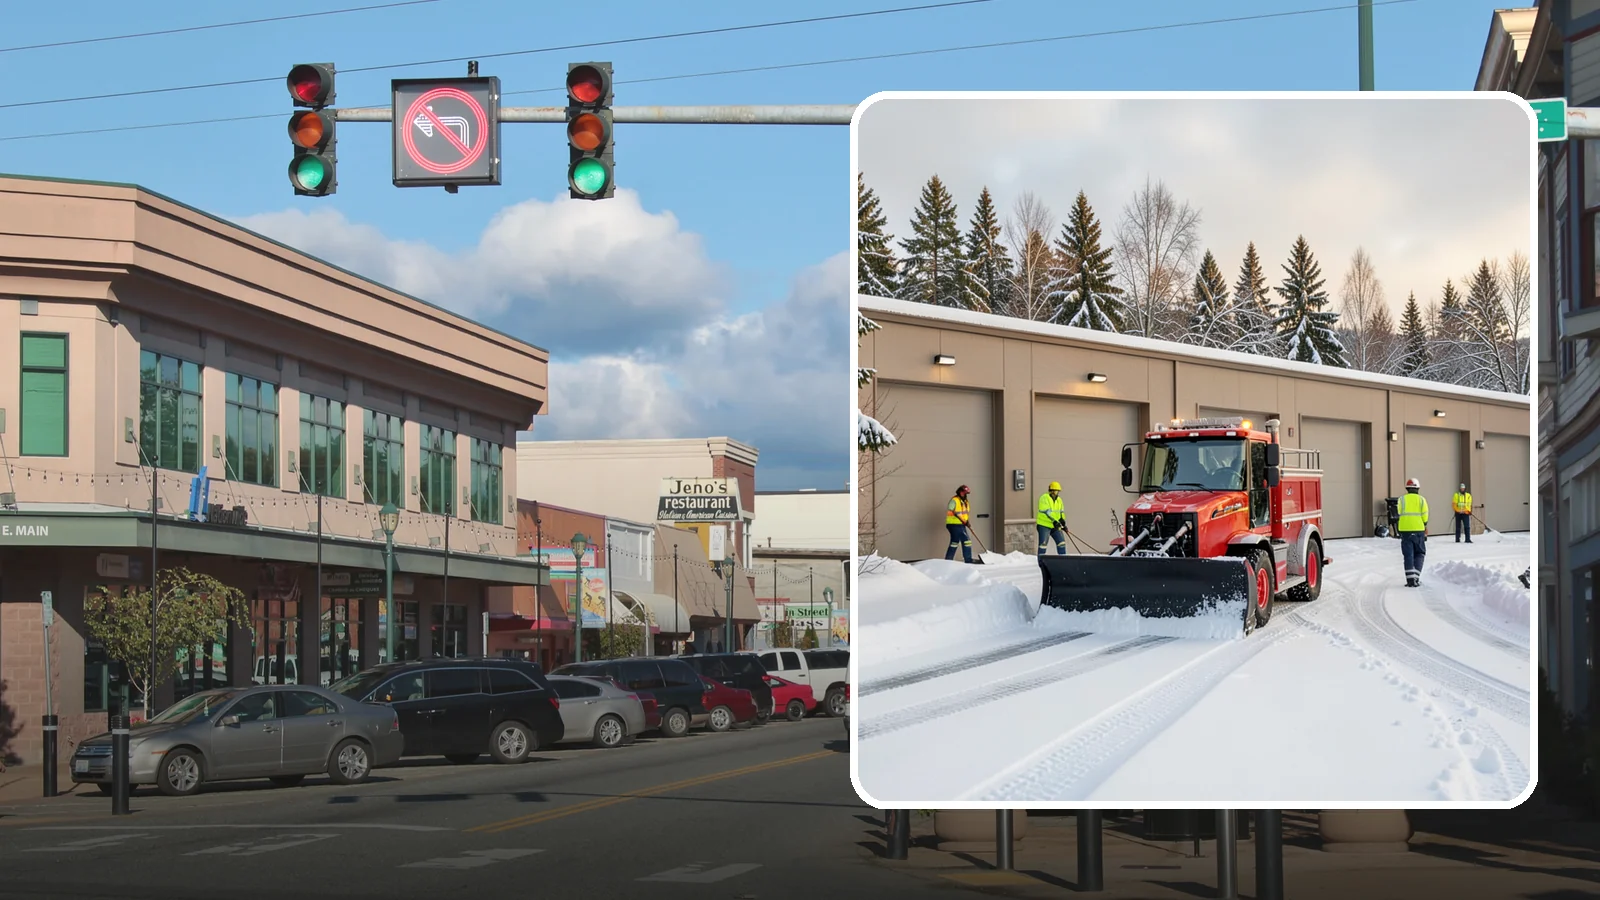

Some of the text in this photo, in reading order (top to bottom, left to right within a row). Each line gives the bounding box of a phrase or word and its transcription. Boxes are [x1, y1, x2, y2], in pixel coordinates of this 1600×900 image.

[670, 480, 728, 494] Jeno's
[665, 496, 731, 509] restaurant
[658, 509, 682, 519] Italian
[686, 509, 715, 519] American
[715, 509, 738, 519] Cuisine
[2, 525, 49, 536] E. MAIN
[797, 607, 829, 617] Street
